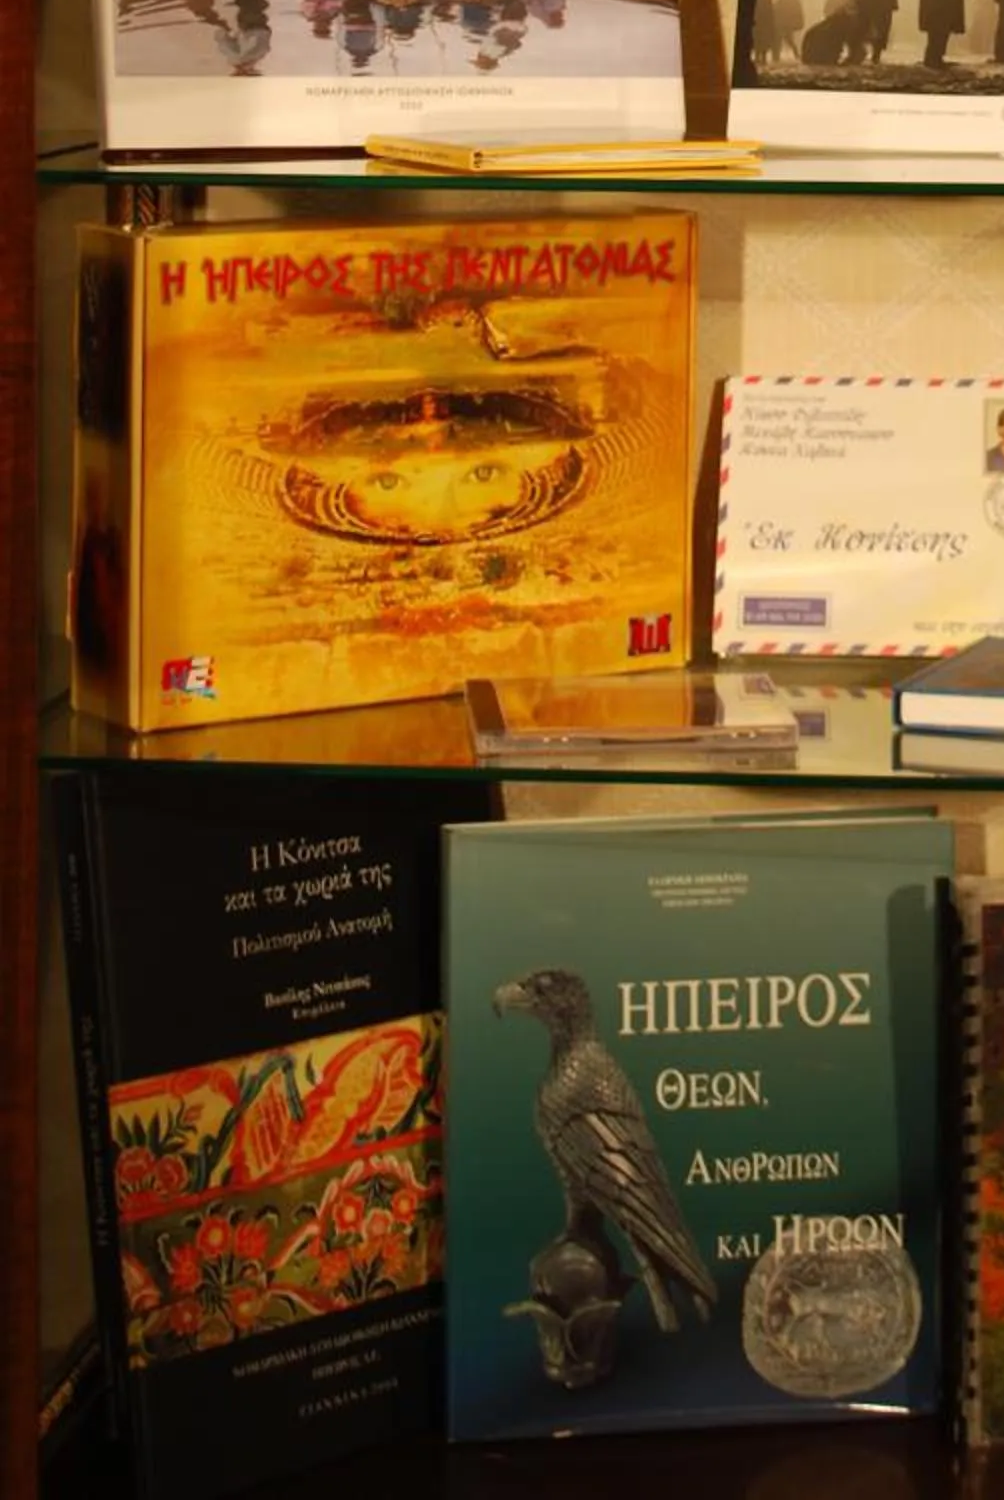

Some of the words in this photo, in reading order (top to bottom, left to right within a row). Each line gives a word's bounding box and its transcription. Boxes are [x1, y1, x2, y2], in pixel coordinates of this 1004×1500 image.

[160, 261, 187, 305] Η
[368, 248, 433, 295] ΤΗΣ
[250, 844, 271, 872] Η
[278, 834, 362, 867] Κόνιτσα
[224, 890, 257, 913] και
[262, 884, 287, 904] τα
[293, 864, 353, 907] χωριά
[359, 862, 393, 892] της
[232, 922, 322, 959] Πολιτισμού
[326, 907, 394, 940] Ανατομή
[617, 972, 872, 1036] ΗΠΕΙΡΟΣ
[685, 1148, 841, 1186] ΑΝΘΡΩΠΩΝ
[716, 1233, 762, 1260] ΚΑΙ
[772, 1213, 906, 1257] ΗΡΩΩΝ
